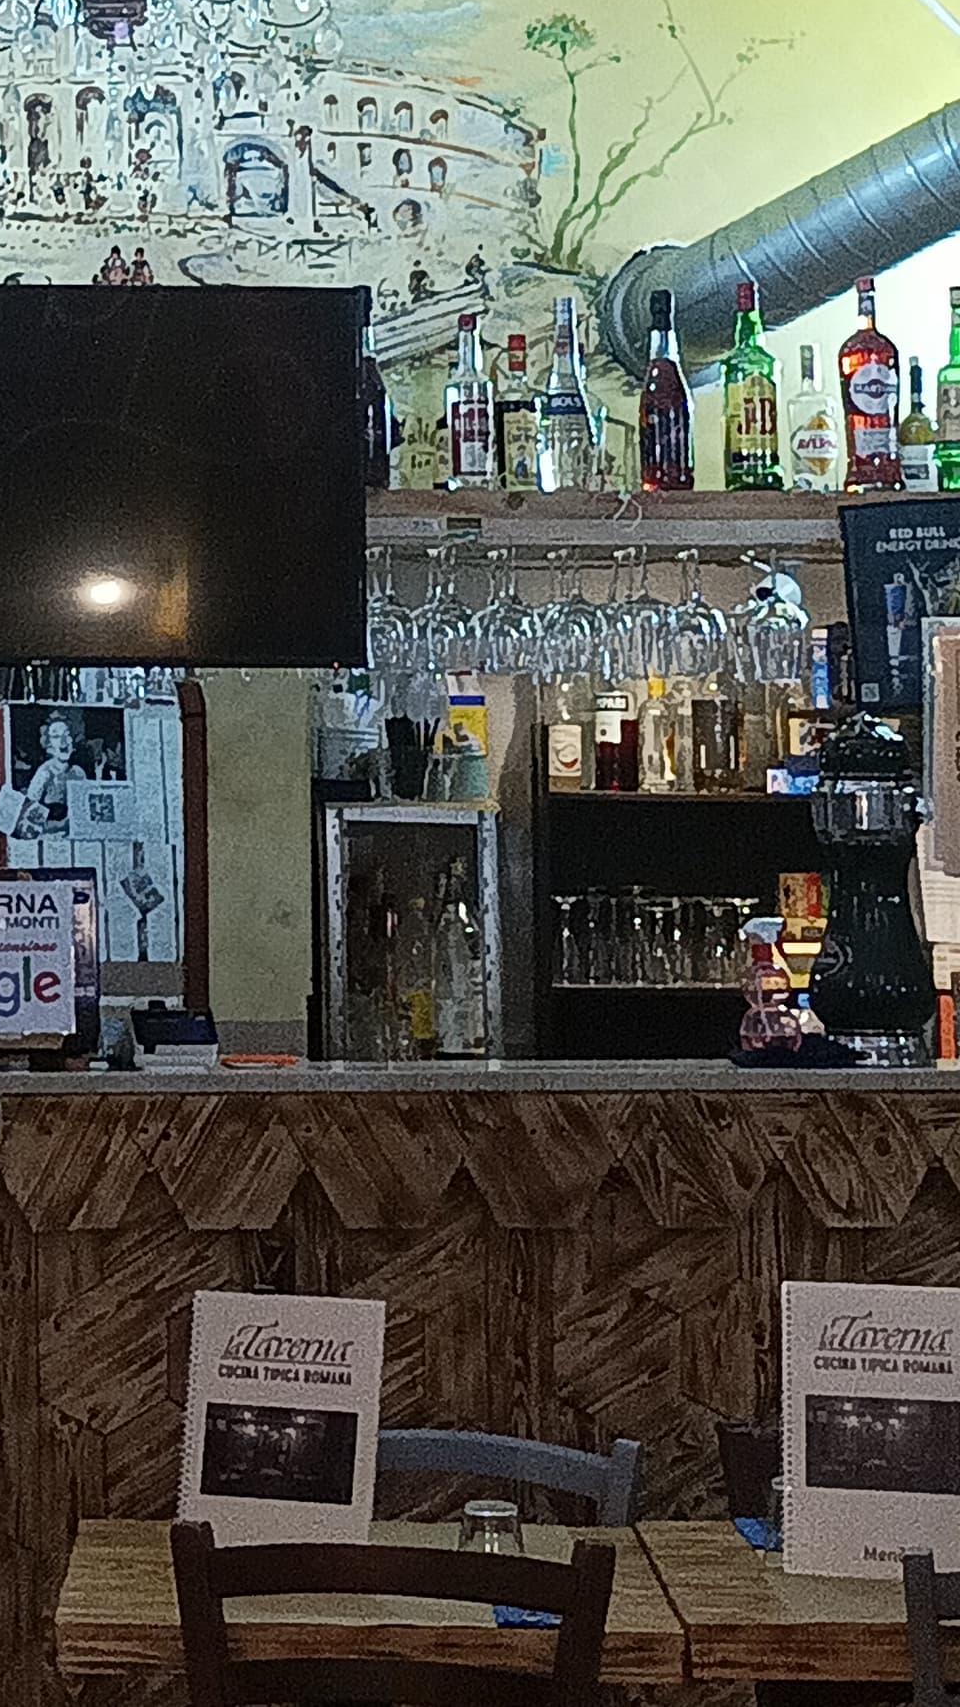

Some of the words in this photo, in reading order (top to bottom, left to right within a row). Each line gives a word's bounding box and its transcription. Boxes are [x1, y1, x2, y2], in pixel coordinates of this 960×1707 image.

[889, 527, 913, 540] RED
[916, 526, 946, 538] BULL
[6, 916, 60, 930] MONTI
[237, 1320, 354, 1363] Taverna
[831, 1311, 953, 1353] Taverna
[218, 1364, 259, 1379] CUCINA
[263, 1366, 300, 1382] TIPICA
[303, 1370, 352, 1385] ROMANA
[814, 1356, 856, 1370] CUCINA
[903, 1359, 953, 1374] ROMANA
